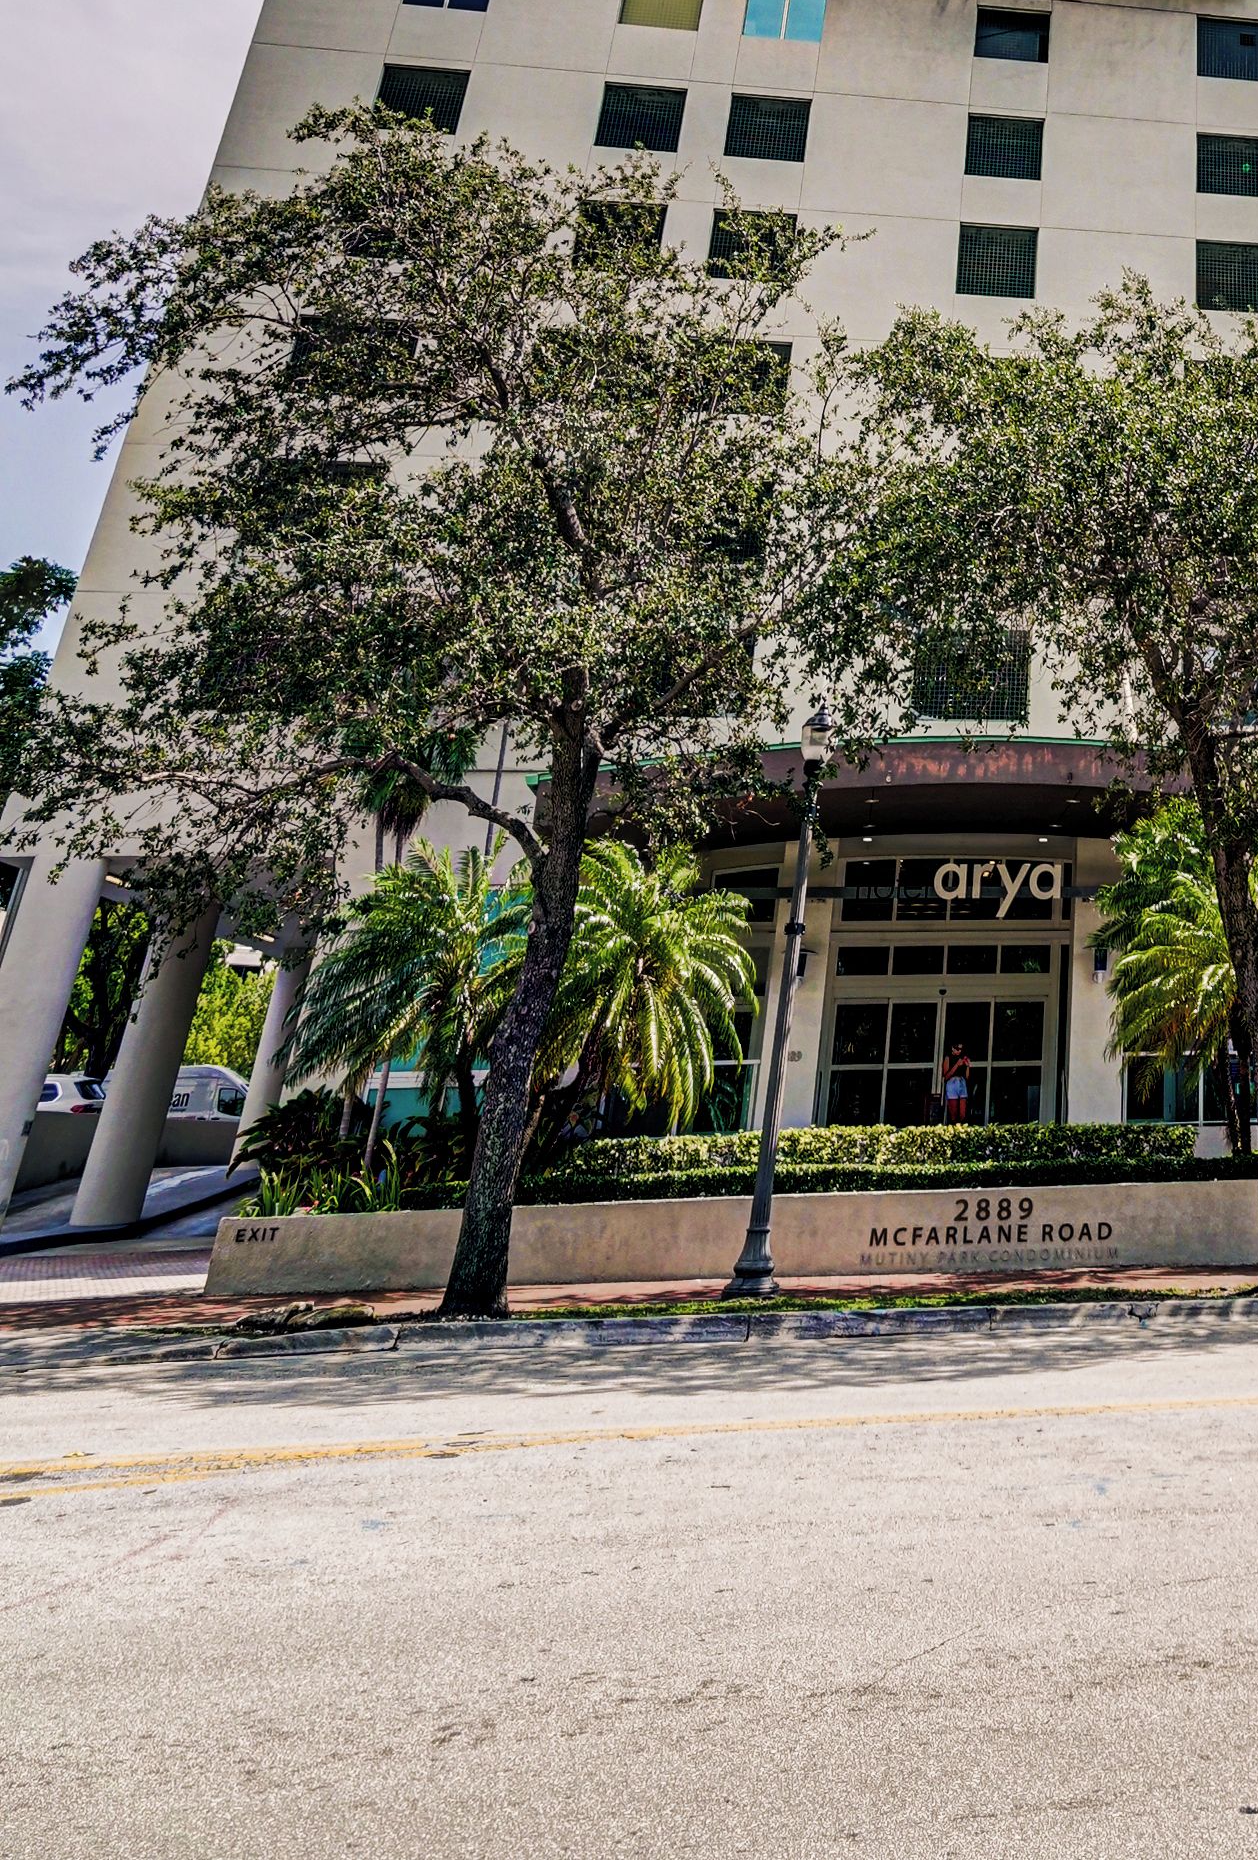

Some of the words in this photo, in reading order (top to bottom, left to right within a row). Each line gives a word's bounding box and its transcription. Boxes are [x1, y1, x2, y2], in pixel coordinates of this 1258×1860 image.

[934, 863, 1062, 918] arya
[954, 1197, 1034, 1222] 2889
[235, 1227, 280, 1242] EXIT
[869, 1224, 1029, 1247] MCFARLANE
[1041, 1222, 1113, 1242] ROAD
[859, 1251, 929, 1267] MUTINY
[937, 1250, 981, 1264] PARK
[987, 1247, 1120, 1264] CONDOMINIUM
